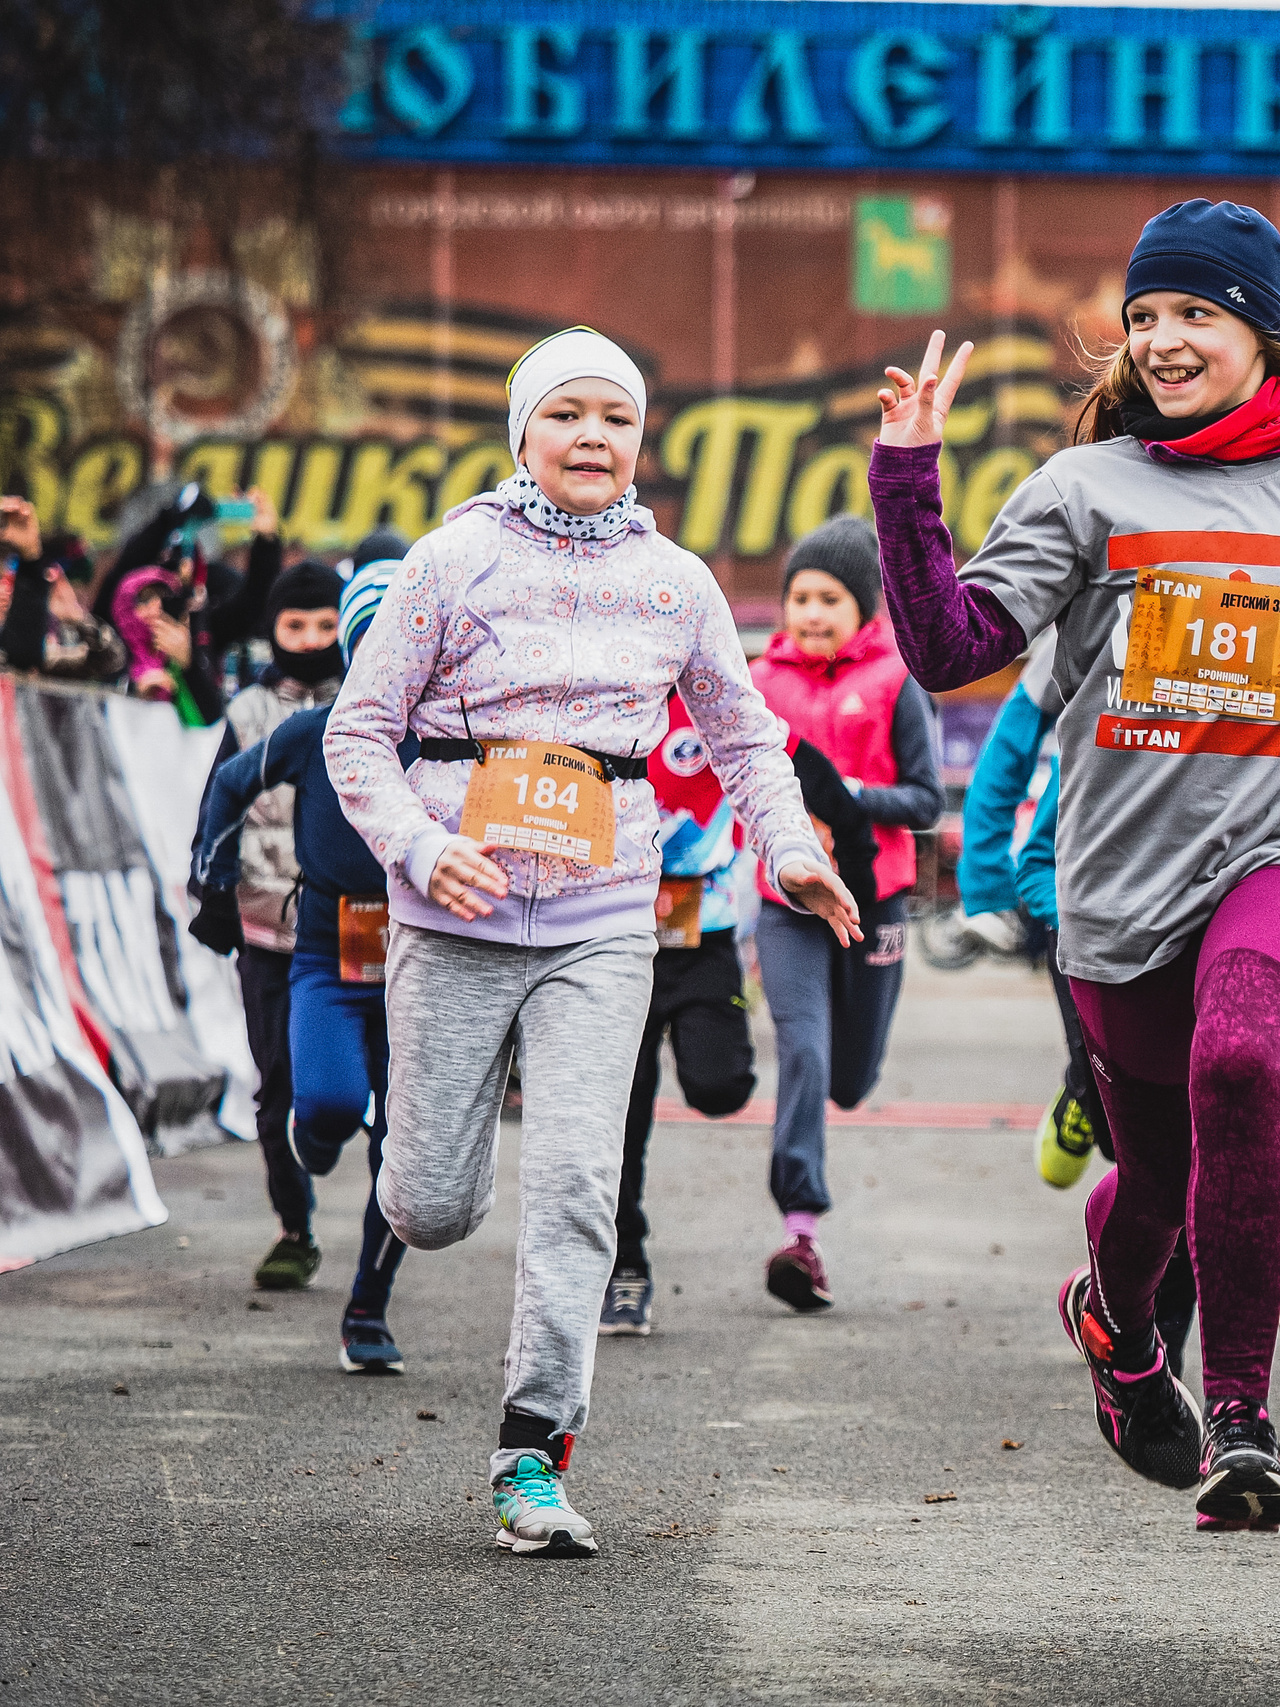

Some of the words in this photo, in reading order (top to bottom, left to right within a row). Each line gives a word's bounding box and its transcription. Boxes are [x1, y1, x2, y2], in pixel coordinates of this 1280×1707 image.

[1142, 574, 1202, 599] TITAN
[1220, 592, 1270, 612] ДЕТСКИЙ
[1186, 618, 1257, 663] 181
[1198, 668, 1249, 685] БРОННИЦЫ
[1112, 723, 1180, 749] TITAN
[543, 752, 586, 773] ДЕТСКИЙ
[513, 773, 579, 814] 184
[523, 814, 568, 830] БРОННИЦЫ
